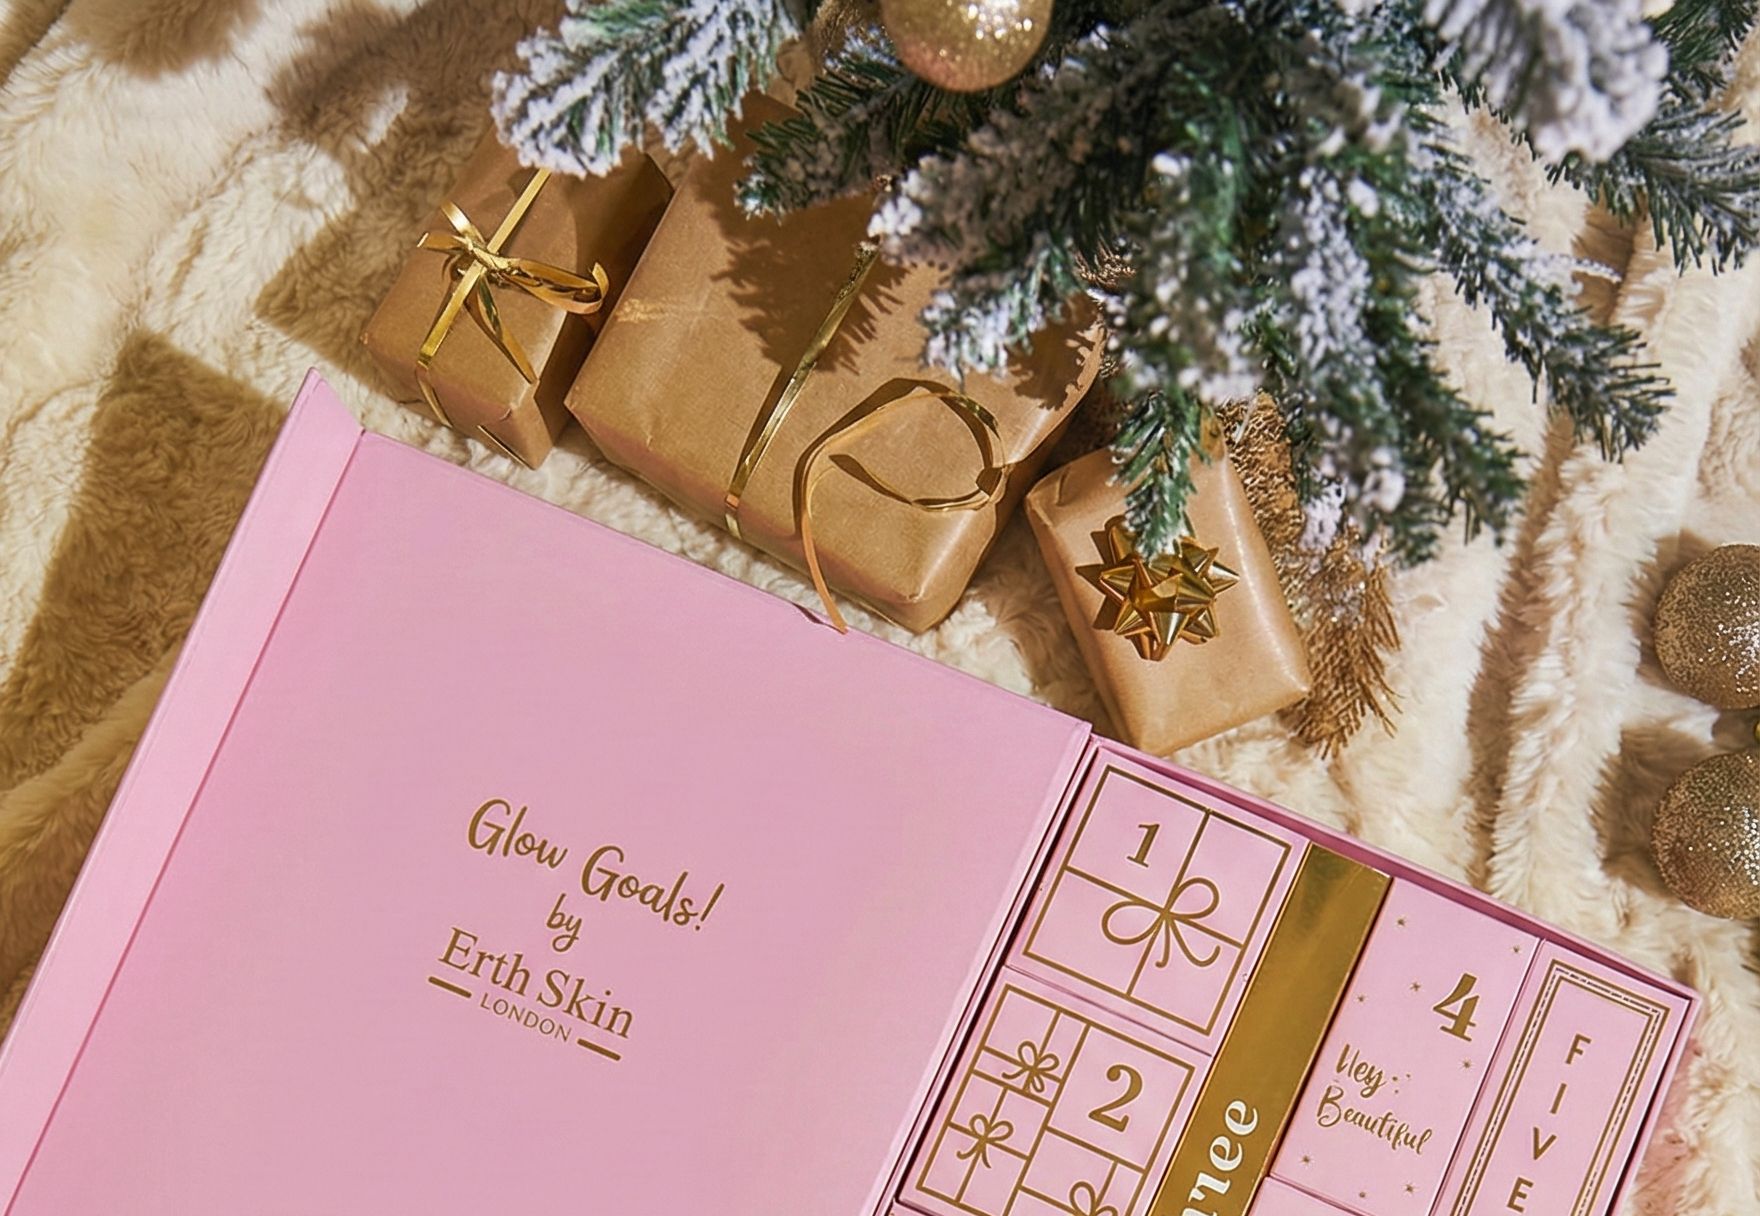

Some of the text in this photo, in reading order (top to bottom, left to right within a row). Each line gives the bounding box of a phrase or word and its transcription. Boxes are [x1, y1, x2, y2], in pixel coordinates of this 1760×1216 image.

[468, 798, 725, 932] Glow Goals!
[1125, 822, 1161, 869] 1
[545, 893, 582, 952] by
[437, 926, 634, 1039] Erth Skin
[1432, 972, 1479, 1042] 4
[480, 993, 572, 1043] LONDON
[1088, 1064, 1143, 1133] 2
[1316, 1084, 1433, 1155] Beautiful
